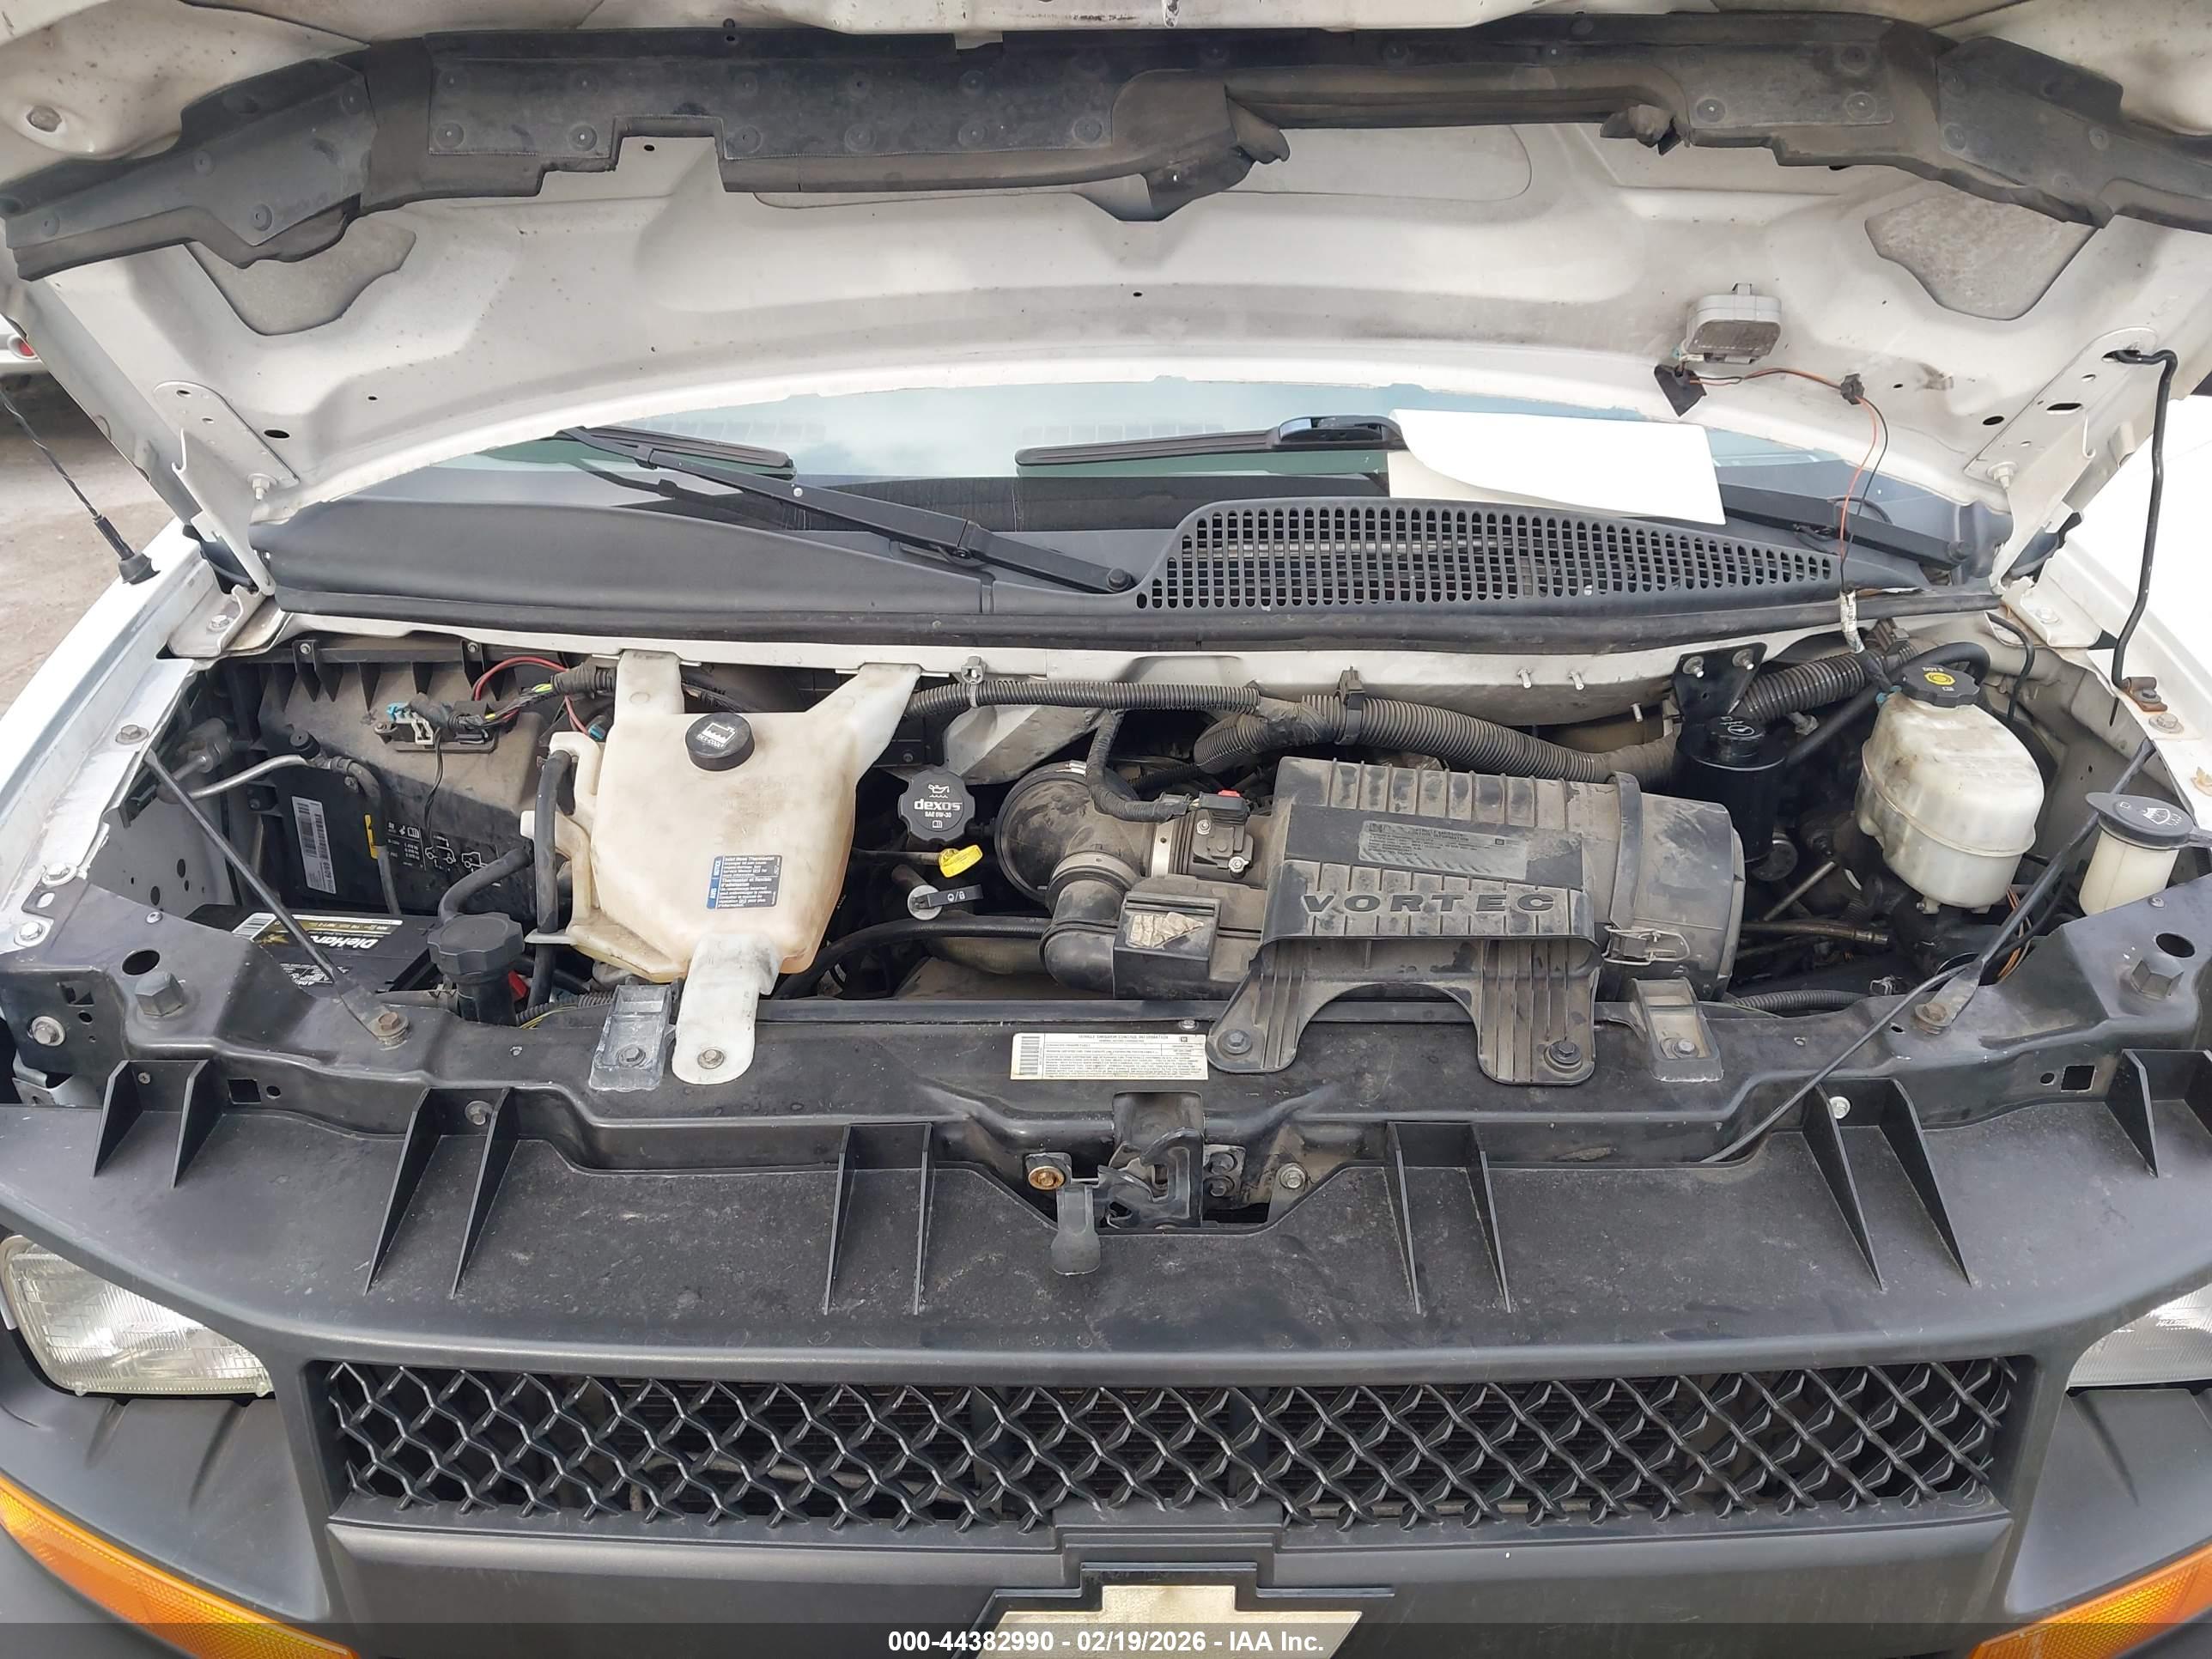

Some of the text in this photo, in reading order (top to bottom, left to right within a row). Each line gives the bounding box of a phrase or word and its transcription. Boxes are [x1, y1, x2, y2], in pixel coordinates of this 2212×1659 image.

[914, 799, 963, 811] dexos
[1303, 894, 1554, 913] VORTEC
[311, 934, 379, 949] DieHar
